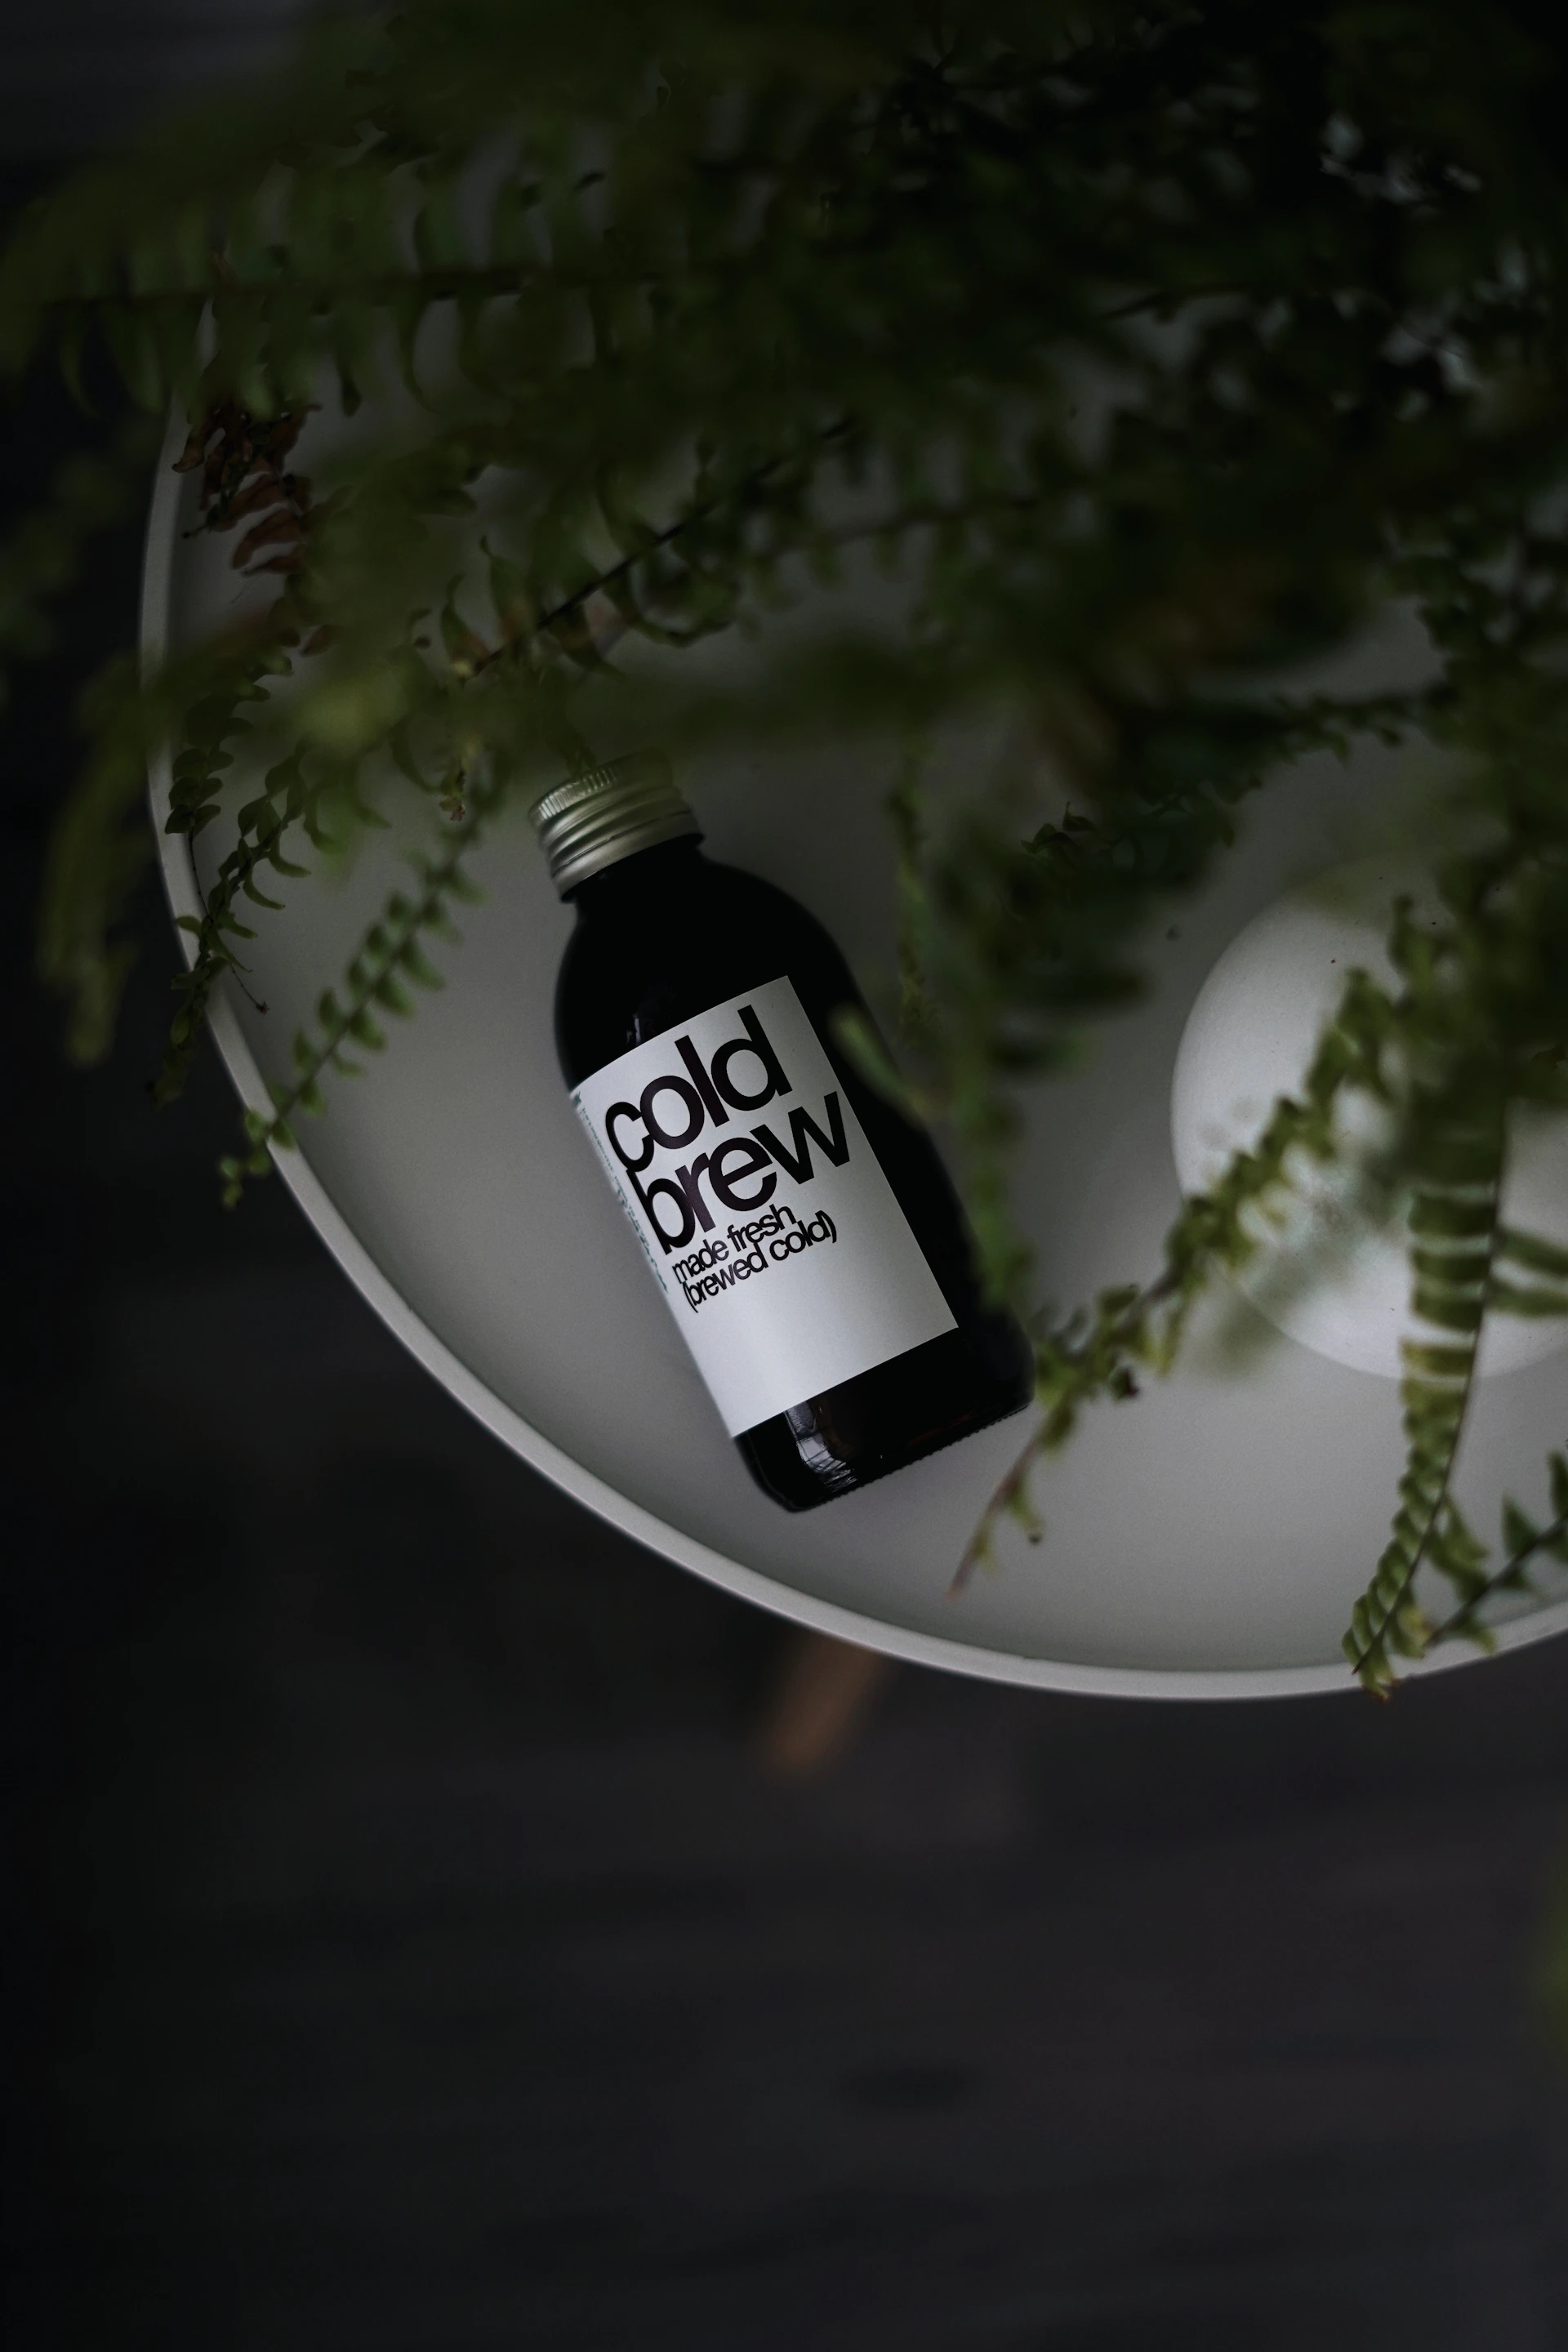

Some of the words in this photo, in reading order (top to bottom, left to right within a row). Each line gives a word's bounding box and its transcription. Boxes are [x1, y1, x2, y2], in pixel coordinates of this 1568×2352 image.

[605, 1004, 793, 1172] cold
[626, 1091, 850, 1254] brew
[672, 1239, 729, 1283] made
[727, 1204, 797, 1252] fresh
[681, 1243, 768, 1313] (brewed
[768, 1210, 837, 1261] cold)
